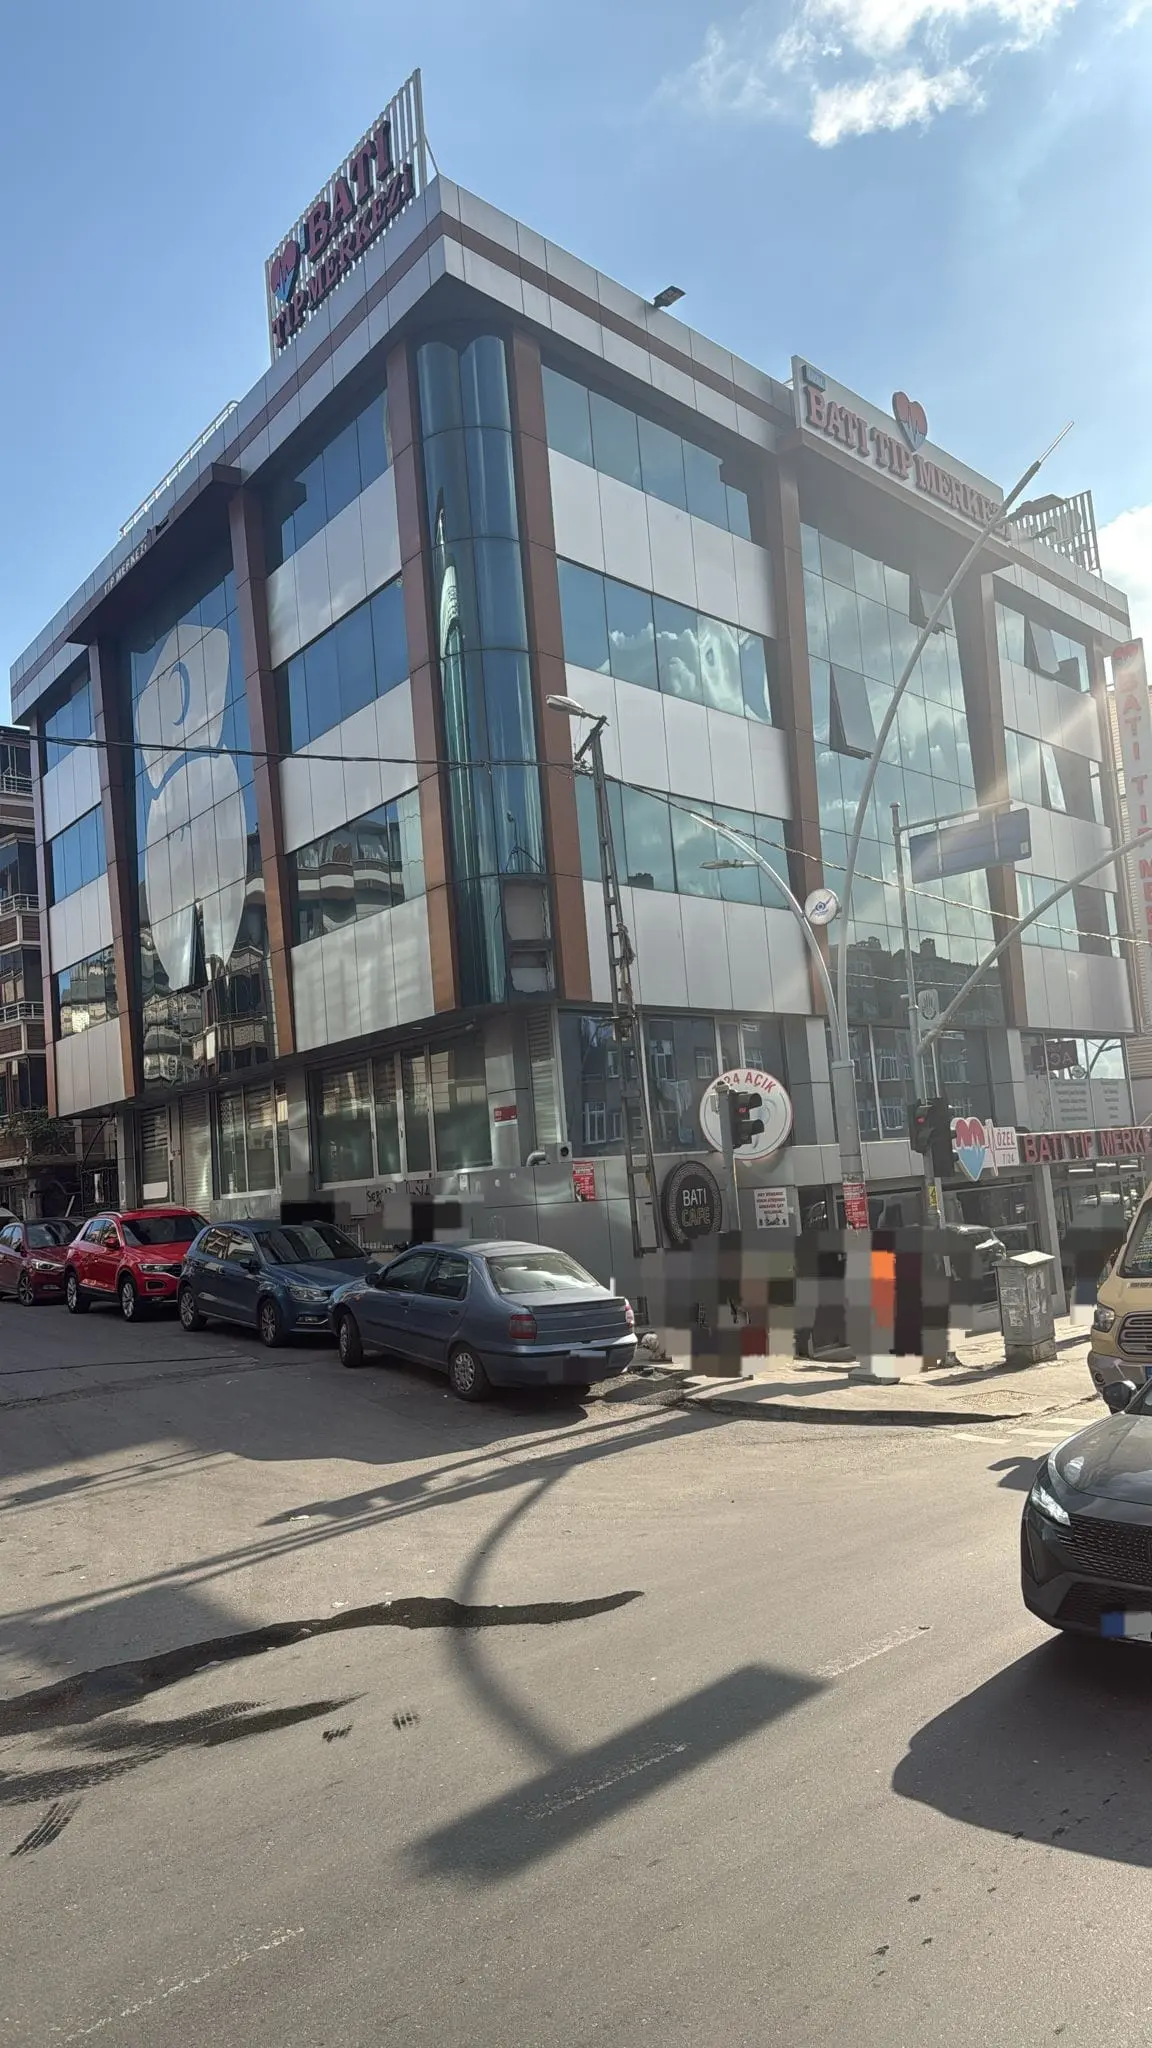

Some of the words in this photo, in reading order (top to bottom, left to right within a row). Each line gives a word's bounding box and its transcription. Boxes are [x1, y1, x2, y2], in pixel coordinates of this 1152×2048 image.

[302, 119, 395, 263] BATI
[271, 289, 308, 349] TIP
[803, 385, 870, 458] BATI
[870, 426, 914, 480] TIP
[1118, 671, 1142, 761] BATI
[744, 1071, 777, 1094] AÇIK
[996, 1129, 1016, 1146] ÖZEL
[1023, 1133, 1069, 1163] BATI
[1068, 1131, 1093, 1159] TIP
[1099, 1126, 1151, 1157] MERK
[682, 1187, 707, 1207] BATI
[681, 1206, 711, 1228] CAFE
